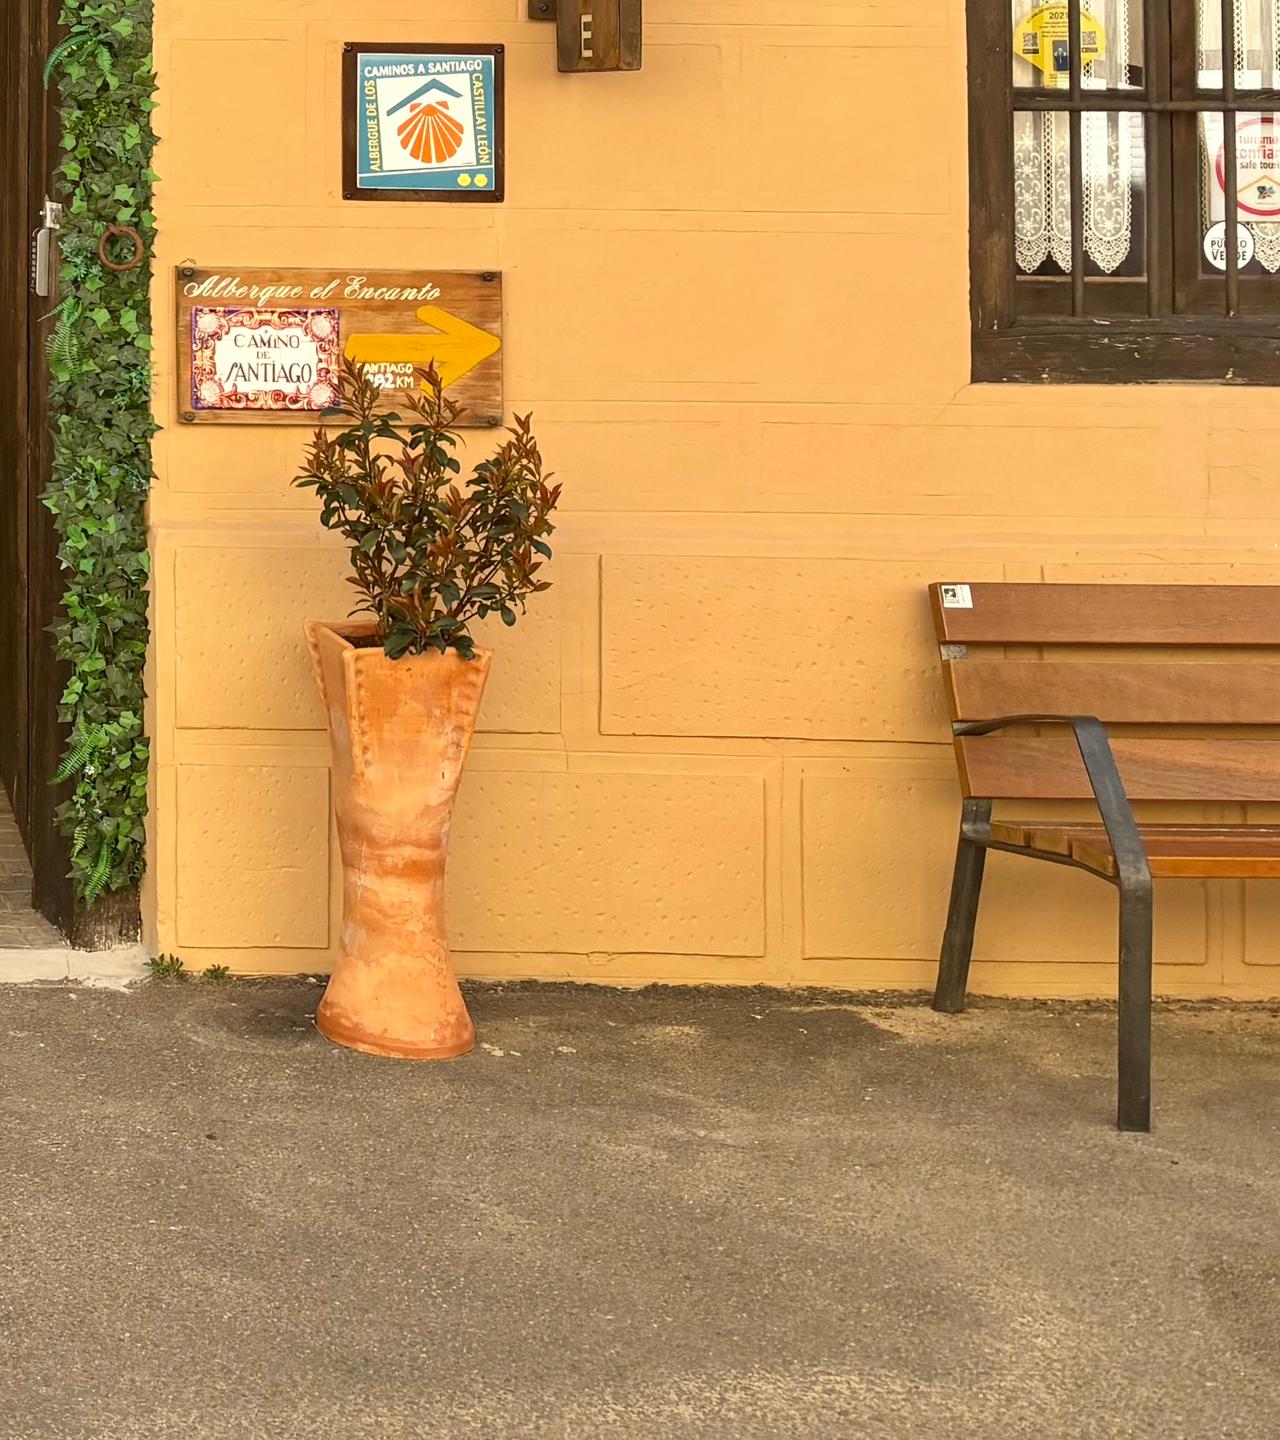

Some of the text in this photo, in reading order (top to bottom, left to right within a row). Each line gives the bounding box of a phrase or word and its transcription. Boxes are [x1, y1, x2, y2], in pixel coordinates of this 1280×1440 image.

[364, 59, 482, 78] CAMINOS A SANTIAGO
[364, 80, 381, 171] ALBERGUE DE LOS
[477, 135, 491, 164] LEÓN
[1240, 160, 1257, 169] safe
[1211, 239, 1247, 248] PUO
[1211, 249, 1247, 261] VEDE
[183, 275, 441, 307] Albergue el Encanto
[233, 333, 300, 348] CAMINO
[256, 351, 271, 359] DE
[225, 360, 312, 384] SANTIAGO
[396, 376, 414, 389] KM
